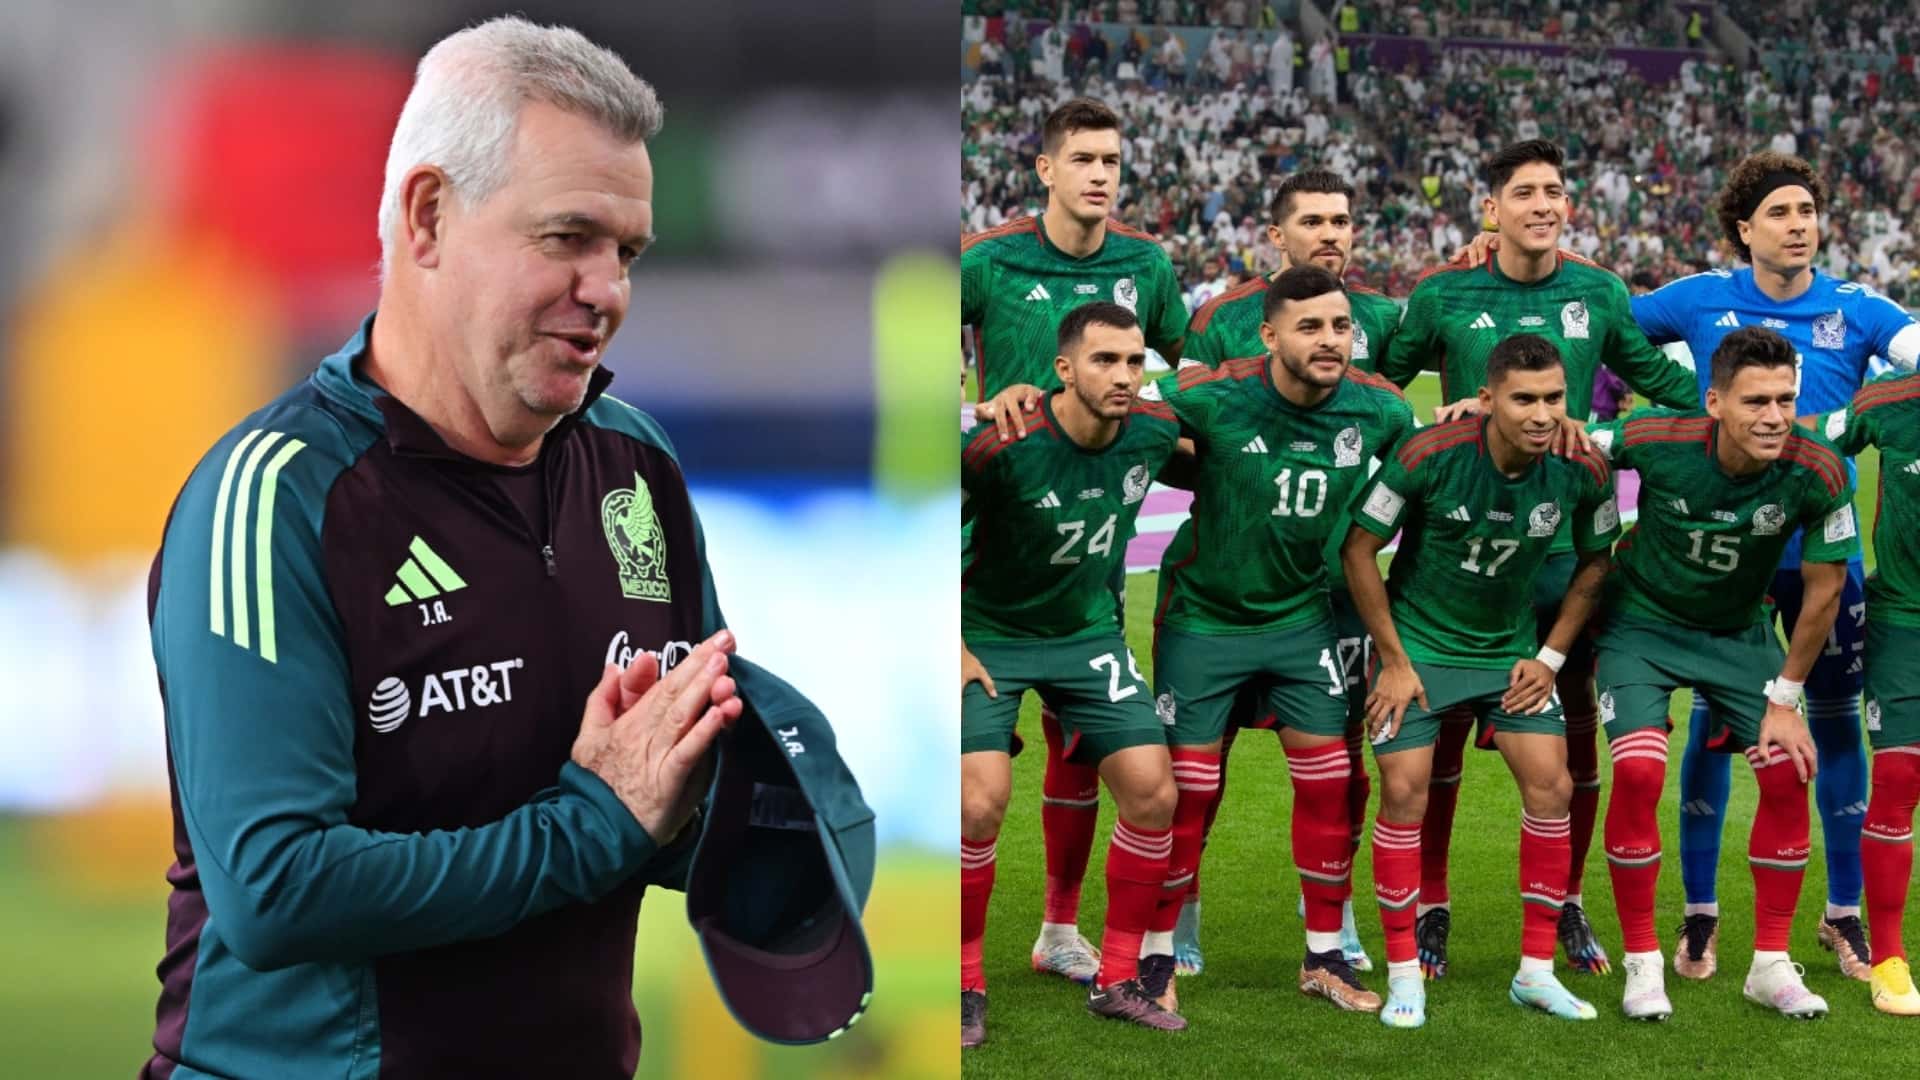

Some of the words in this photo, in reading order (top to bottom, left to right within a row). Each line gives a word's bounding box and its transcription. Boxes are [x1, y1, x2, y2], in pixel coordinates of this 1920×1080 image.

[1271, 468, 1328, 517] 10
[1049, 513, 1118, 565] 24
[1460, 536, 1520, 577] 17
[1685, 528, 1742, 572] 15
[418, 600, 453, 626] J.A.
[419, 663, 515, 717] AT&T
[777, 726, 806, 758] J.A.
